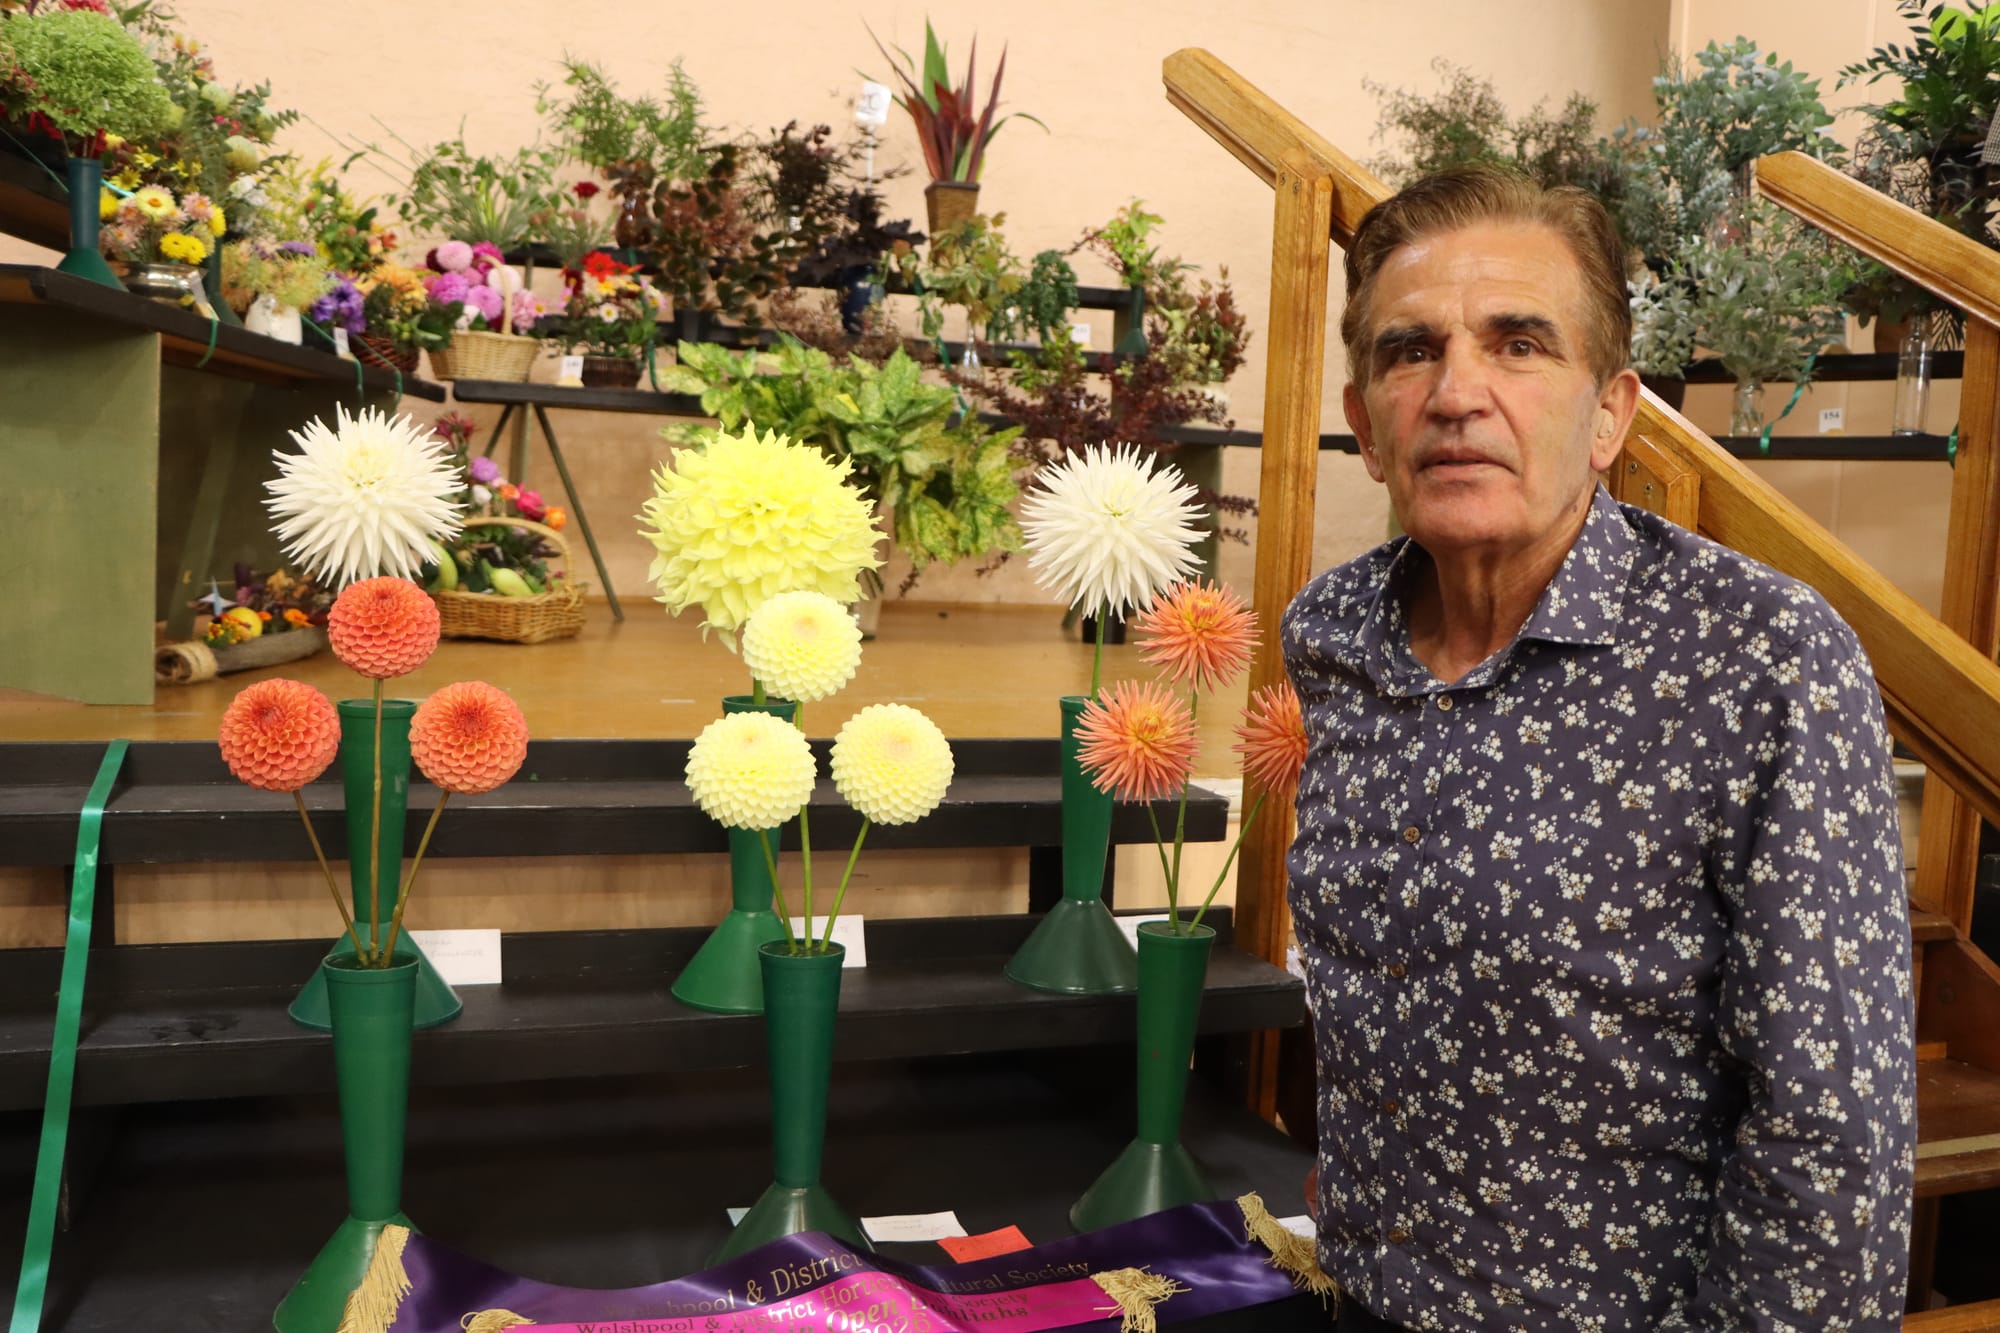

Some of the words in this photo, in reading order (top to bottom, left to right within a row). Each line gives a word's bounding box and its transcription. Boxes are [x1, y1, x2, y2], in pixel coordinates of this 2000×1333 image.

[746, 1279, 766, 1306] &
[771, 1250, 863, 1297] District
[1008, 1262, 1090, 1285] Society
[576, 1318, 695, 1333] Welshpool
[704, 1315, 722, 1329] &
[733, 1299, 817, 1328] District
[952, 1292, 1029, 1307] Society
[826, 1299, 899, 1333] Open
[857, 1311, 931, 1333] 026
